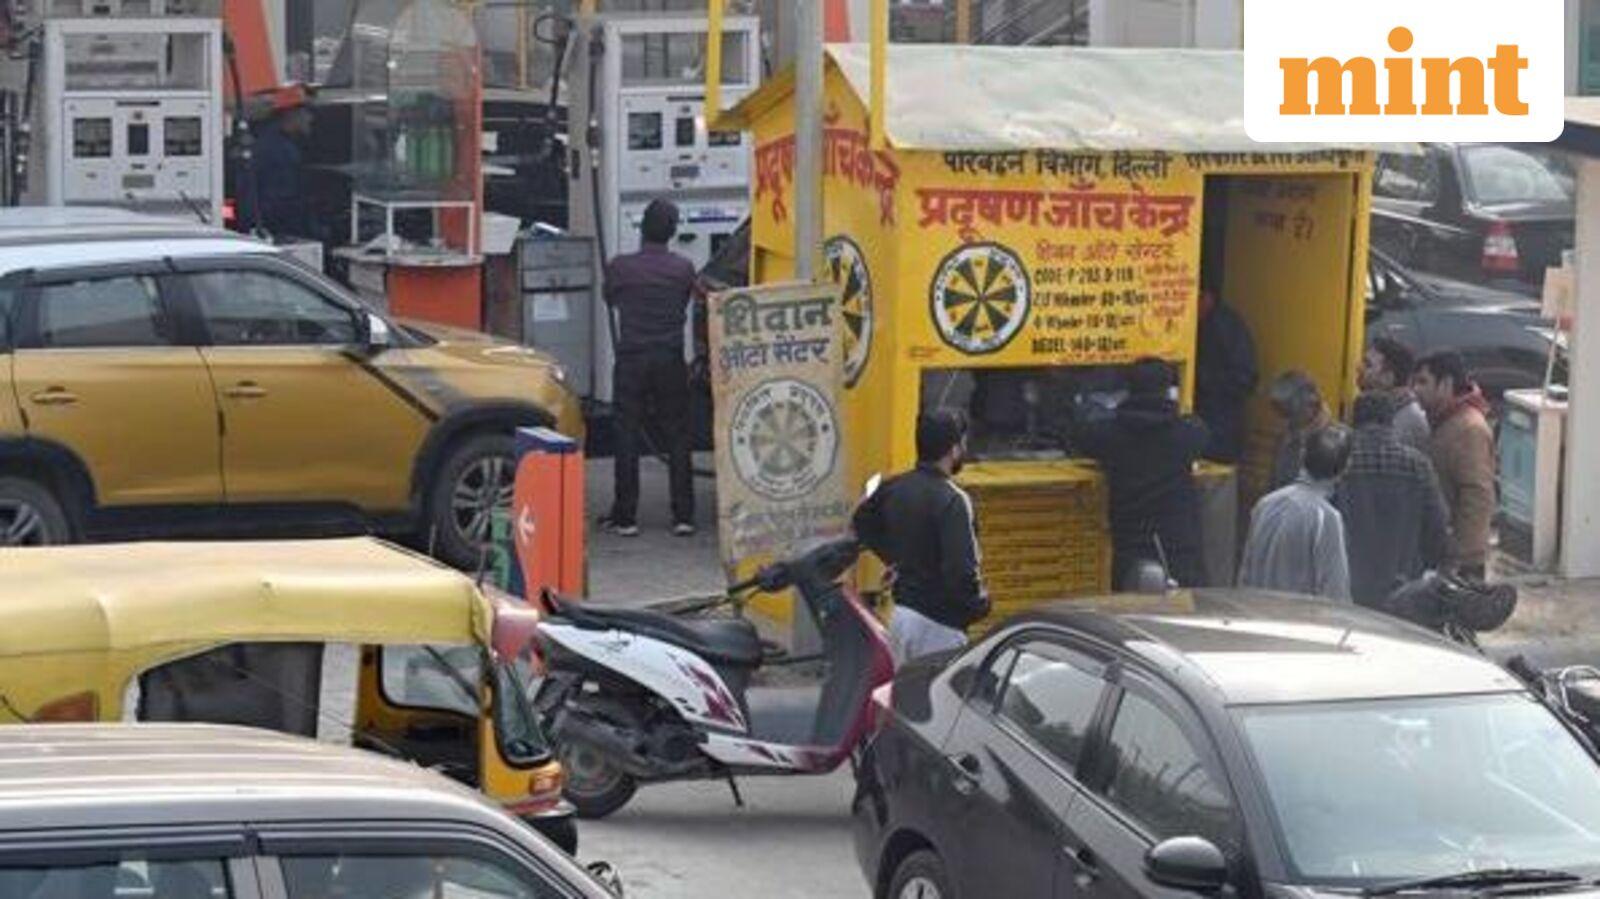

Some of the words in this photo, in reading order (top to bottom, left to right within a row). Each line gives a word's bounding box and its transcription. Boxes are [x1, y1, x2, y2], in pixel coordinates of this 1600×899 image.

[915, 188, 1045, 244] प्रदूषण
[1044, 178, 1128, 231] जाँच
[1128, 181, 1195, 237] केन्द्र
